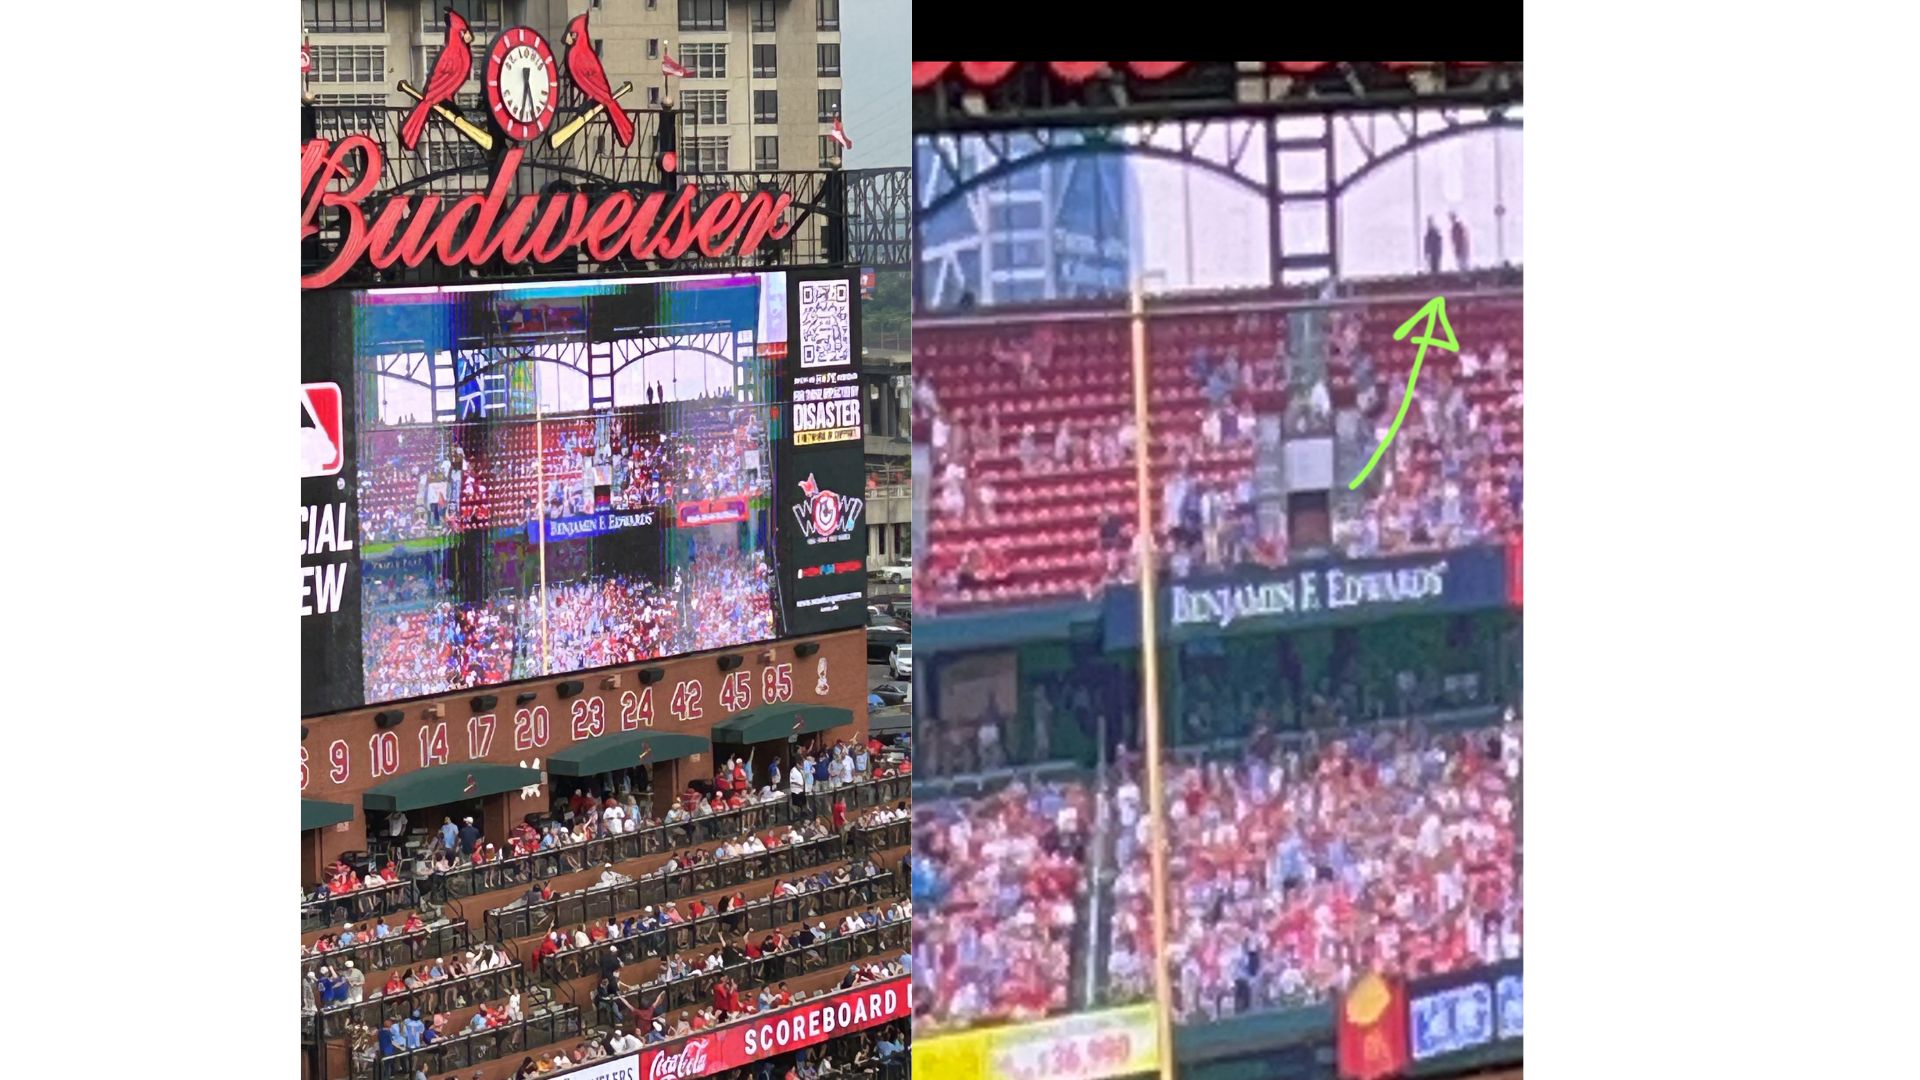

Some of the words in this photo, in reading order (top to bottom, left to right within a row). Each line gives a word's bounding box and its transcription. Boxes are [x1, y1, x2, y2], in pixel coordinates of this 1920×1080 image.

[518, 48, 544, 71] LOUIS
[301, 134, 791, 289] Budweiser
[793, 399, 860, 431] DISASTER
[1171, 580, 1295, 628] BENJAMIN
[1327, 565, 1444, 608] EDWARDS
[329, 739, 349, 784] 9
[370, 732, 400, 777] 10
[419, 722, 449, 767] 14
[468, 714, 496, 759] 17
[515, 705, 549, 750] 20
[572, 696, 604, 741] 23
[621, 687, 654, 731] 24
[671, 680, 702, 721] 42
[720, 671, 751, 712] 45
[762, 663, 794, 704] 85
[744, 987, 896, 1056] SCOREBOARD
